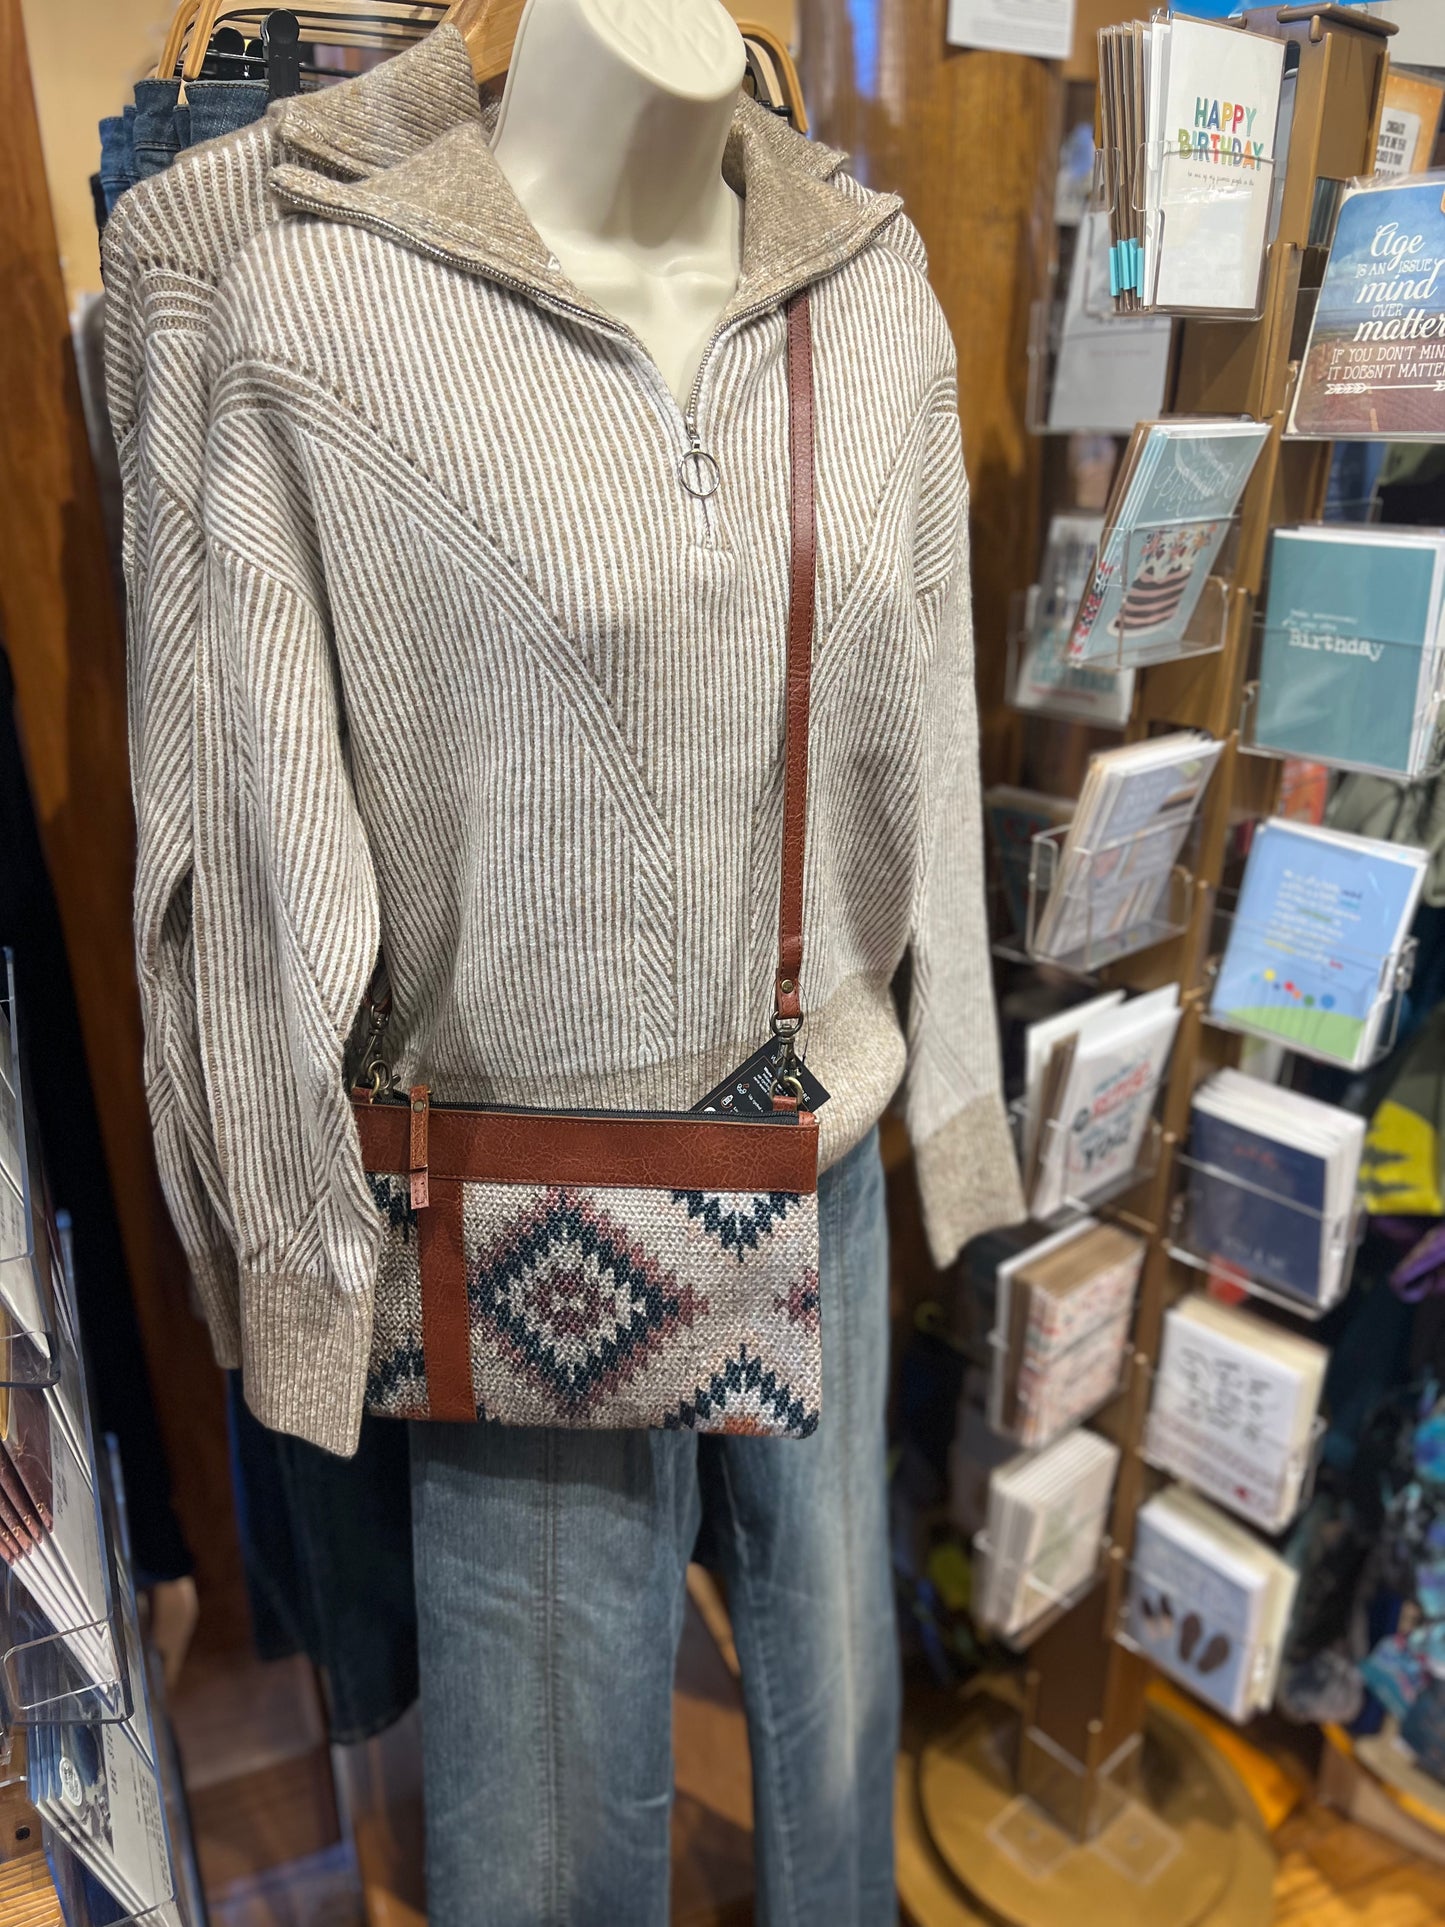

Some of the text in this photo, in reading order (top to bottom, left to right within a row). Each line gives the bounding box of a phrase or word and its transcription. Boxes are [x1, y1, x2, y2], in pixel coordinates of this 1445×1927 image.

[1194, 96, 1257, 137] HAPPY
[1178, 128, 1264, 171] BIRTHDAY
[1370, 222, 1426, 272] Age
[1355, 258, 1433, 278] IS AN ISSUE
[1356, 258, 1445, 304] mind
[1352, 307, 1445, 342] matter
[1371, 303, 1404, 318] OVER
[1327, 366, 1342, 380] IT
[1342, 364, 1396, 380] DOESN'T
[1330, 348, 1345, 365] IF
[1348, 347, 1373, 363] YOU
[1376, 345, 1416, 361] DON'T
[1289, 628, 1385, 663] Birthday
